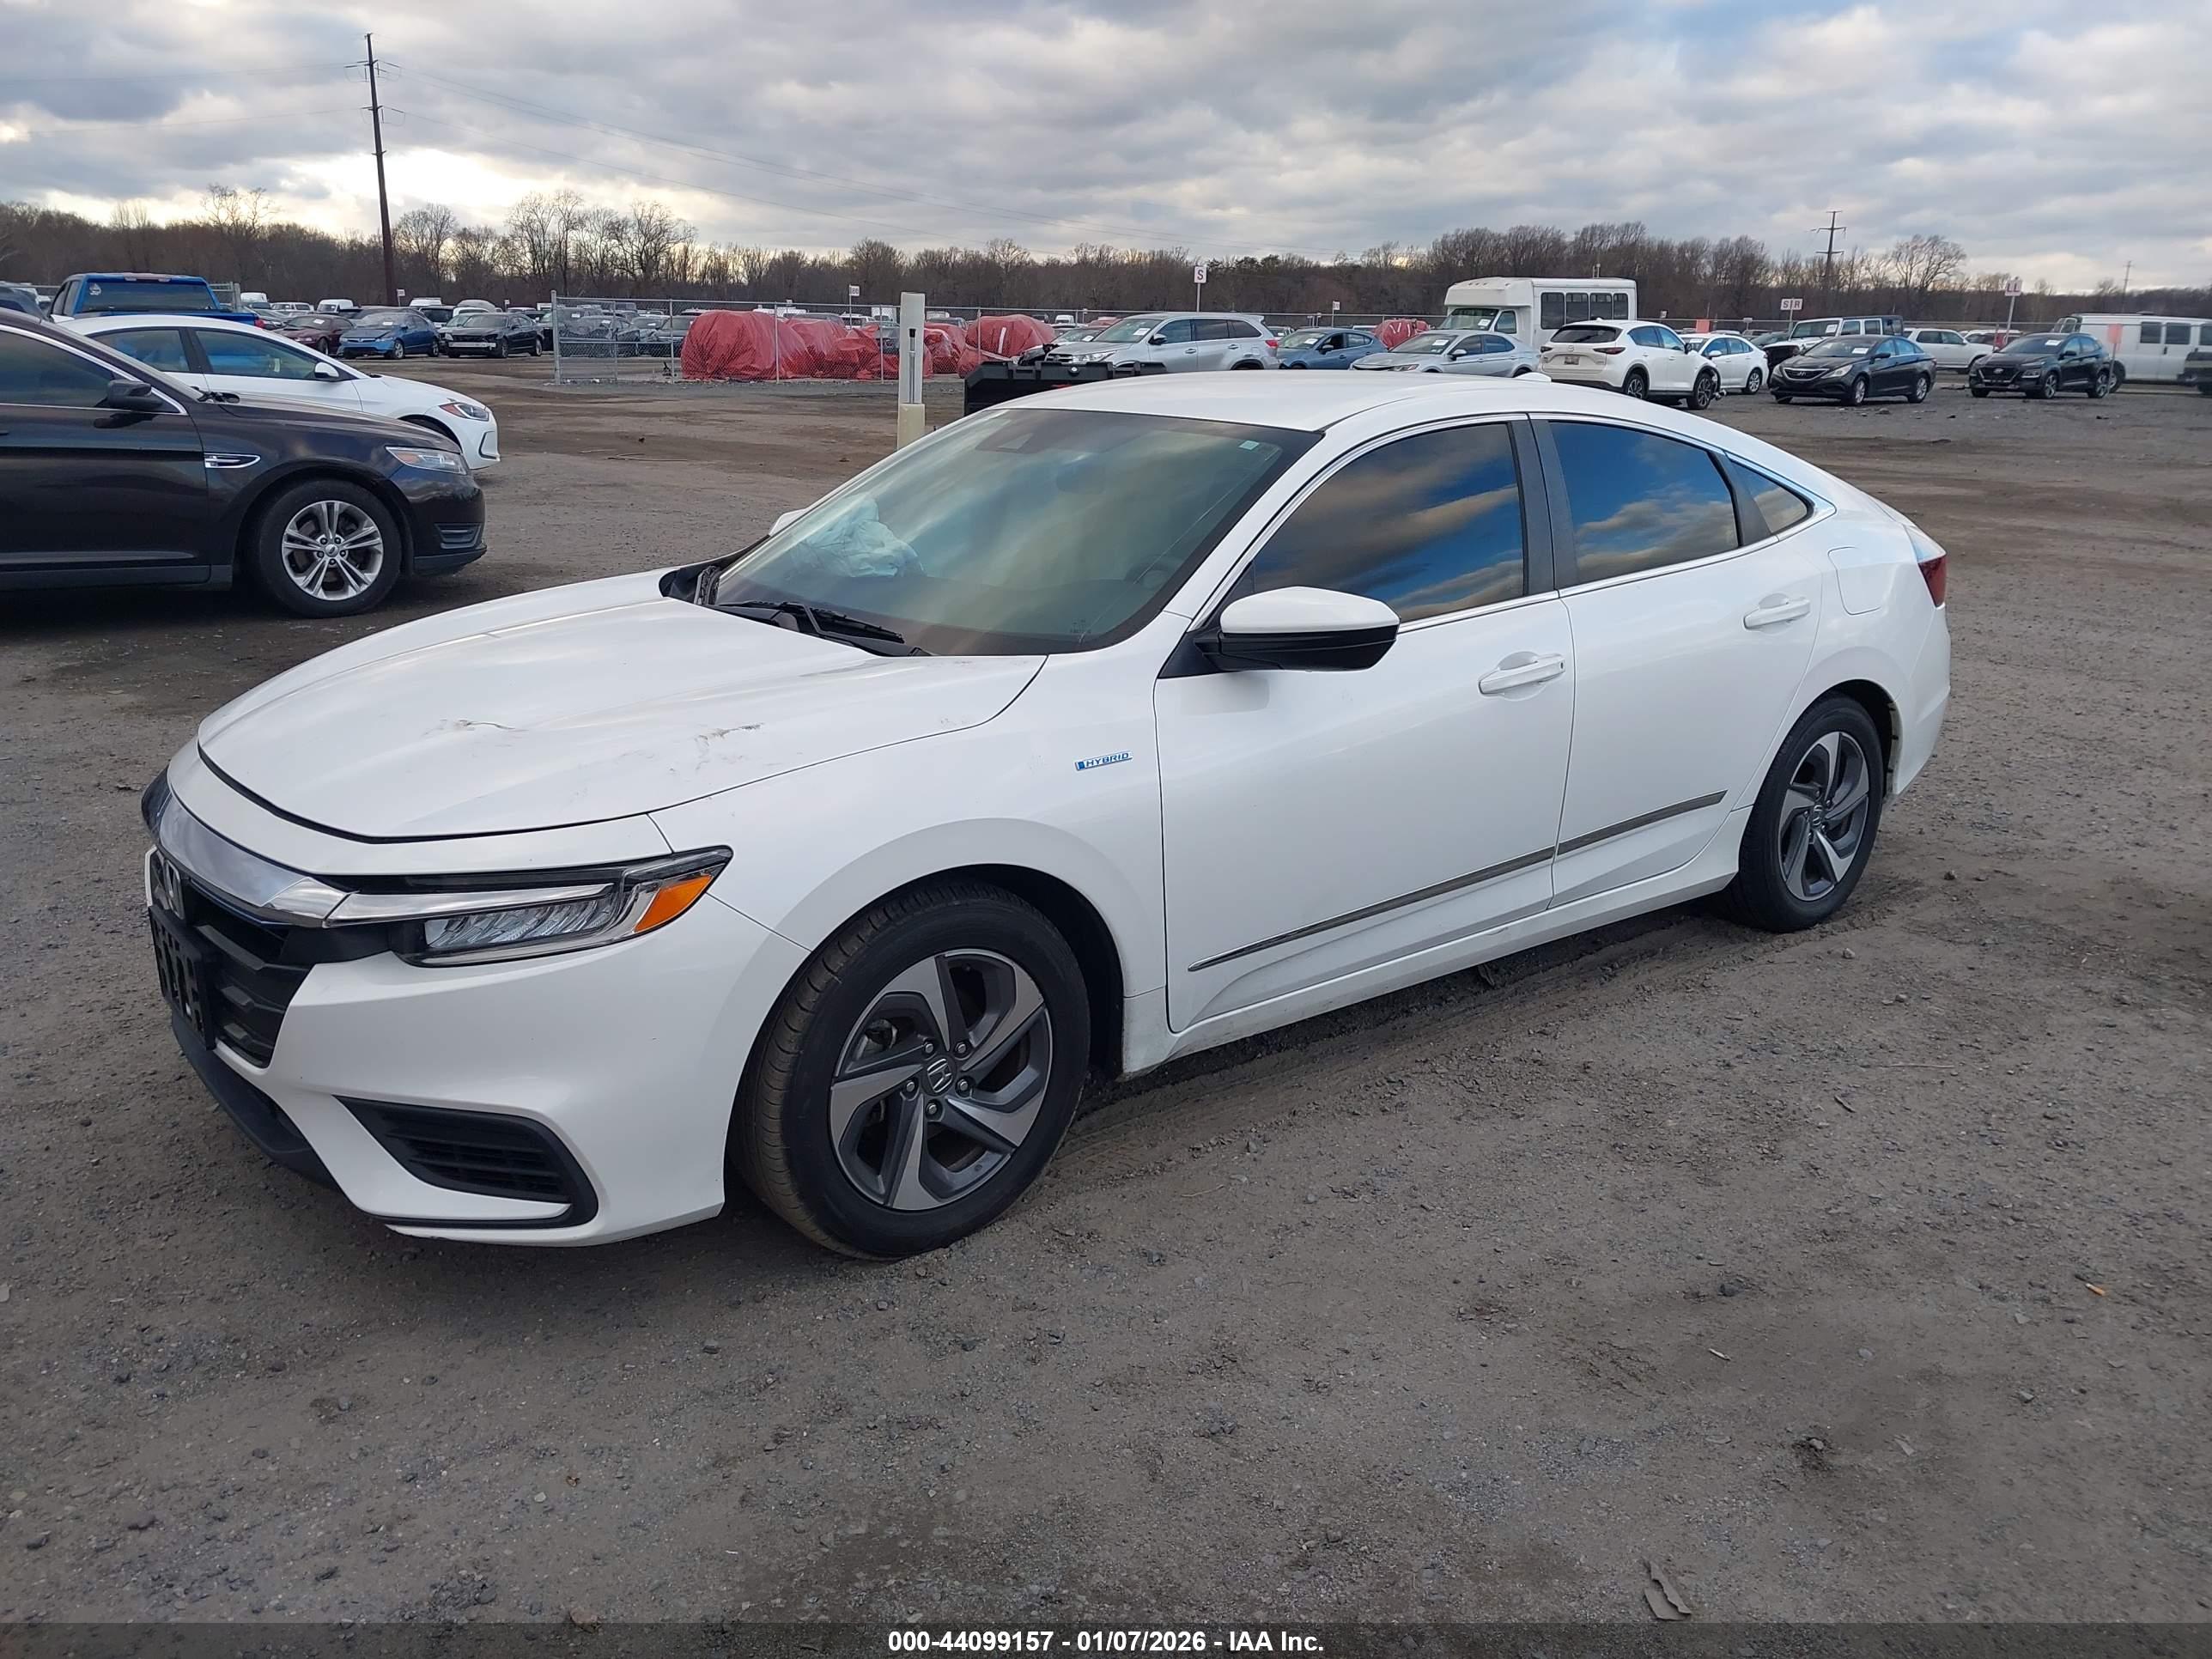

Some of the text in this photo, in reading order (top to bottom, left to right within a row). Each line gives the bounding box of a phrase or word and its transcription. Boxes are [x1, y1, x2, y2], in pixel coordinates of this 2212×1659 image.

[1197, 269, 1204, 281] S
[2007, 283, 2021, 293] LL
[1086, 752, 1129, 767] HYBRID
